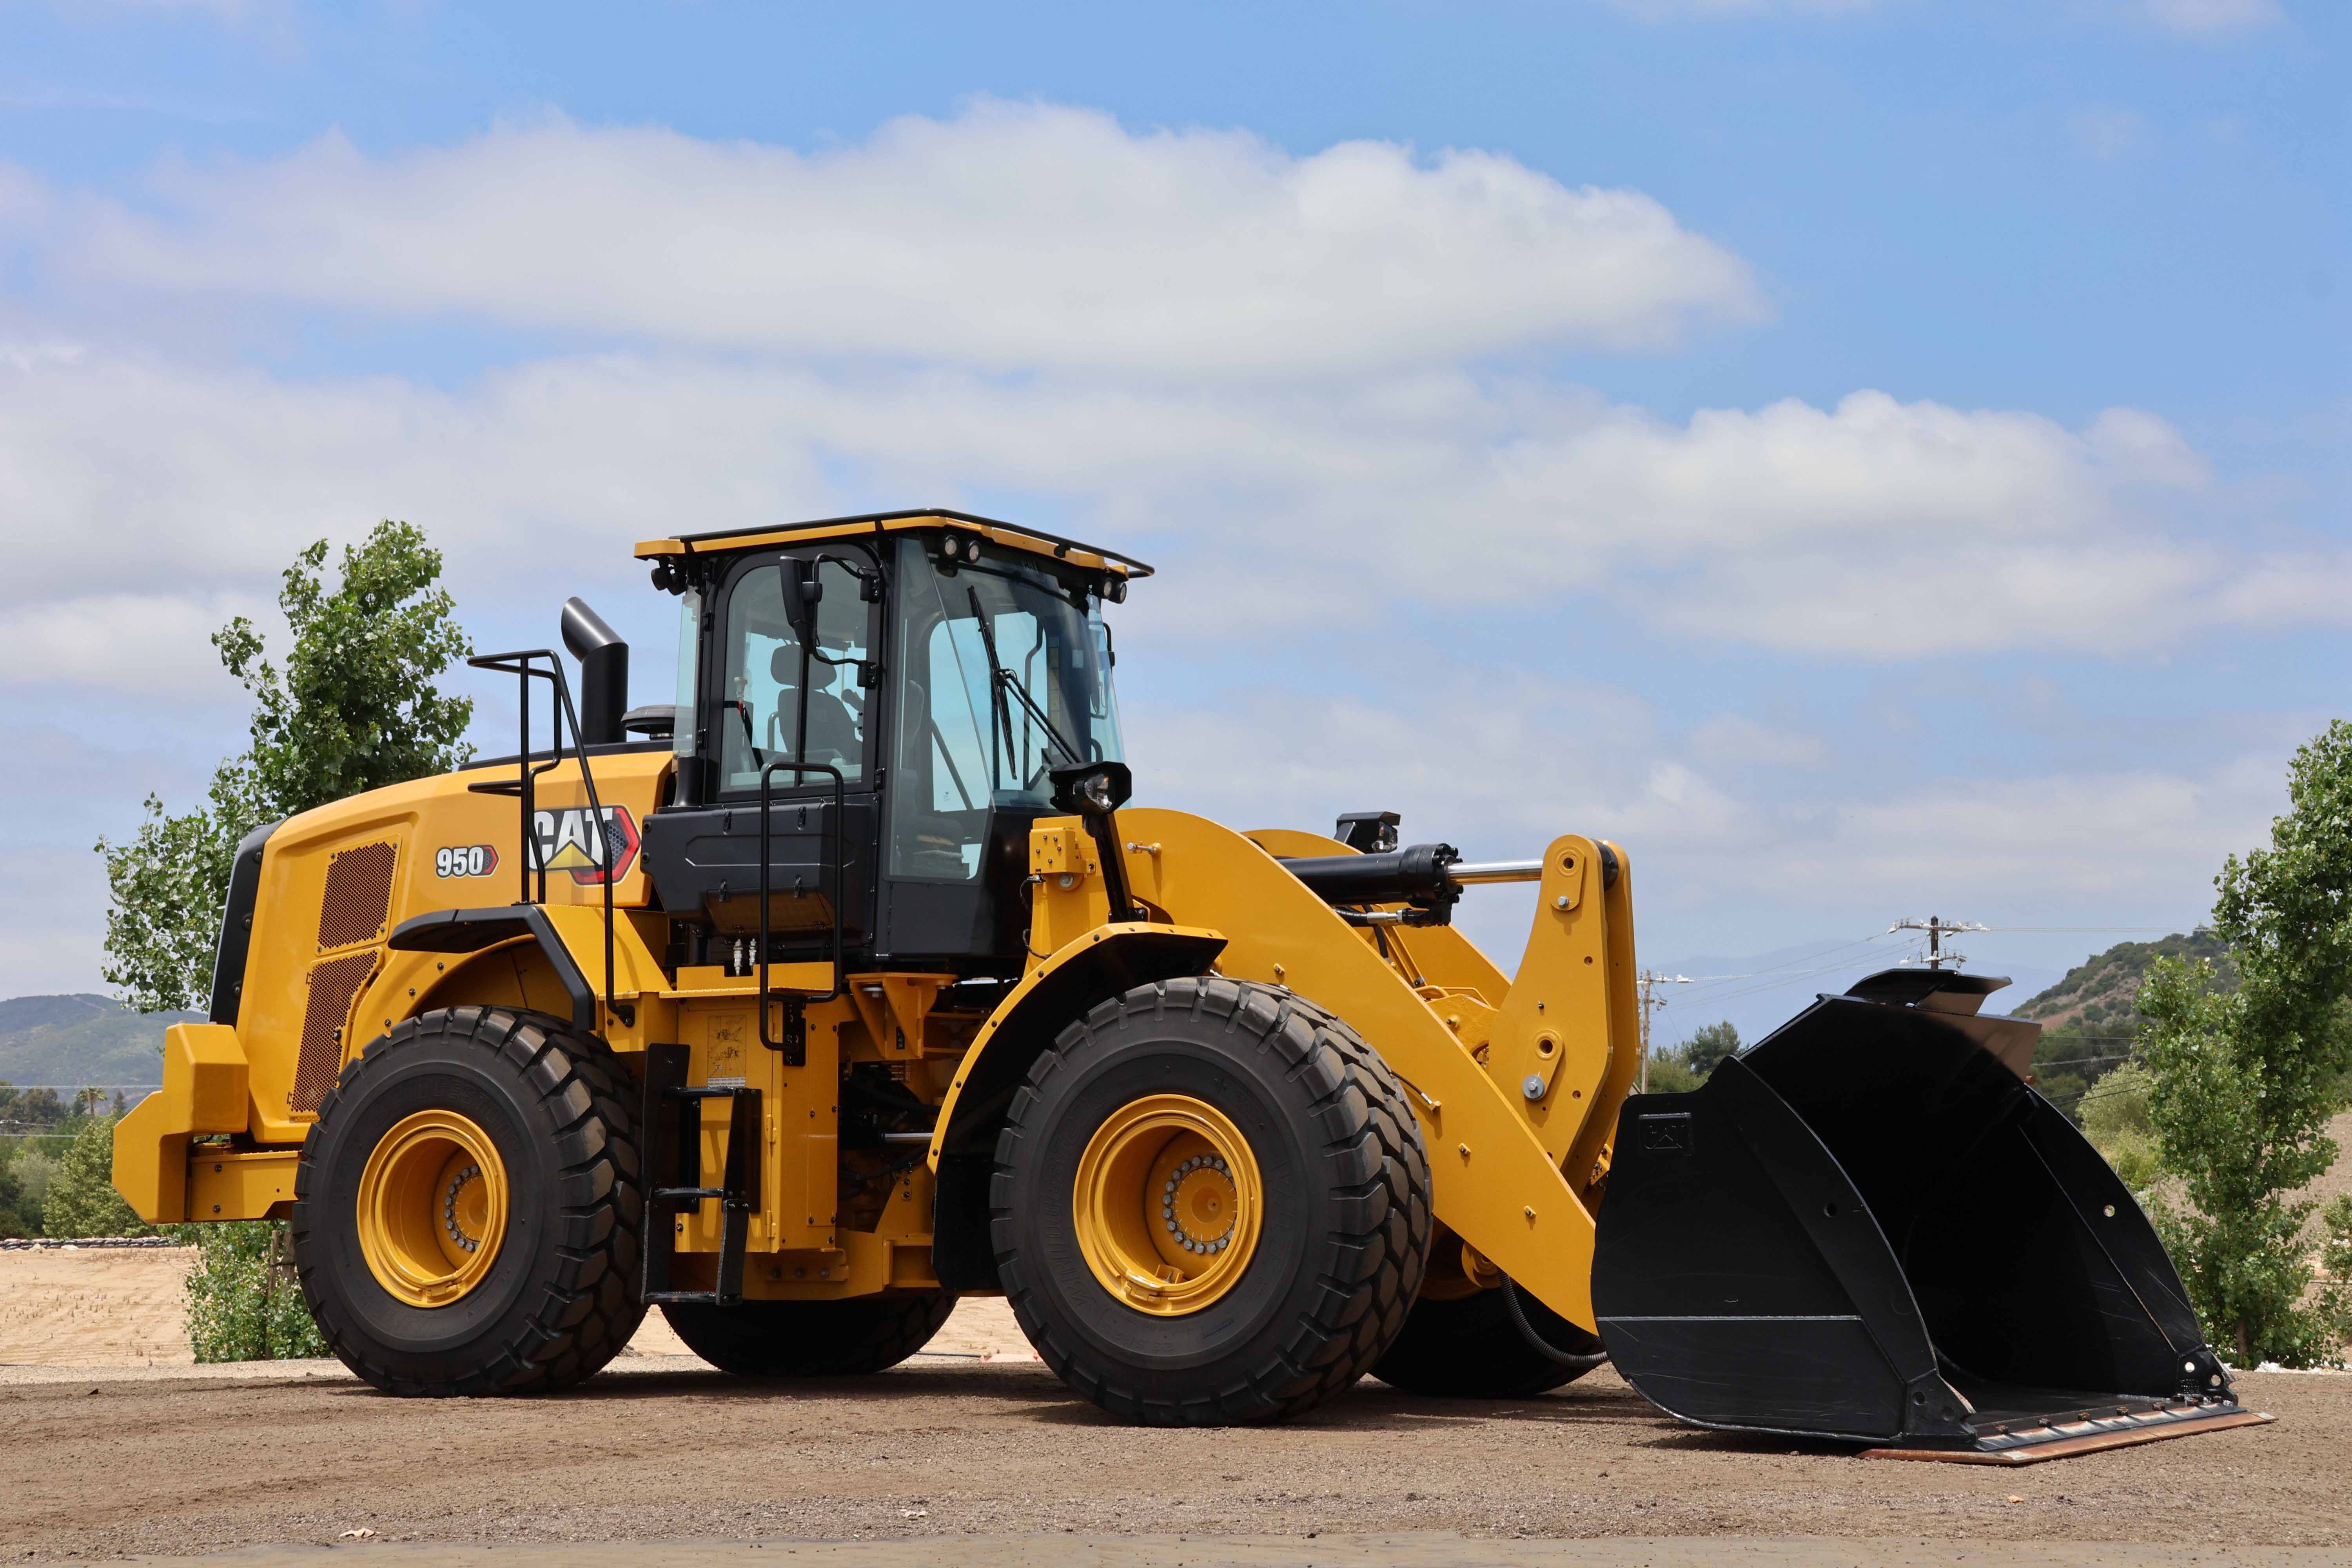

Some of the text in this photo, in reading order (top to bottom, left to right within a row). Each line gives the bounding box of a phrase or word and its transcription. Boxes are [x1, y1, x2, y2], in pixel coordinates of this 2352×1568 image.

[437, 846, 484, 876] 950
[529, 808, 613, 869] CAT
[374, 1076, 521, 1152] RIDGESTONE
